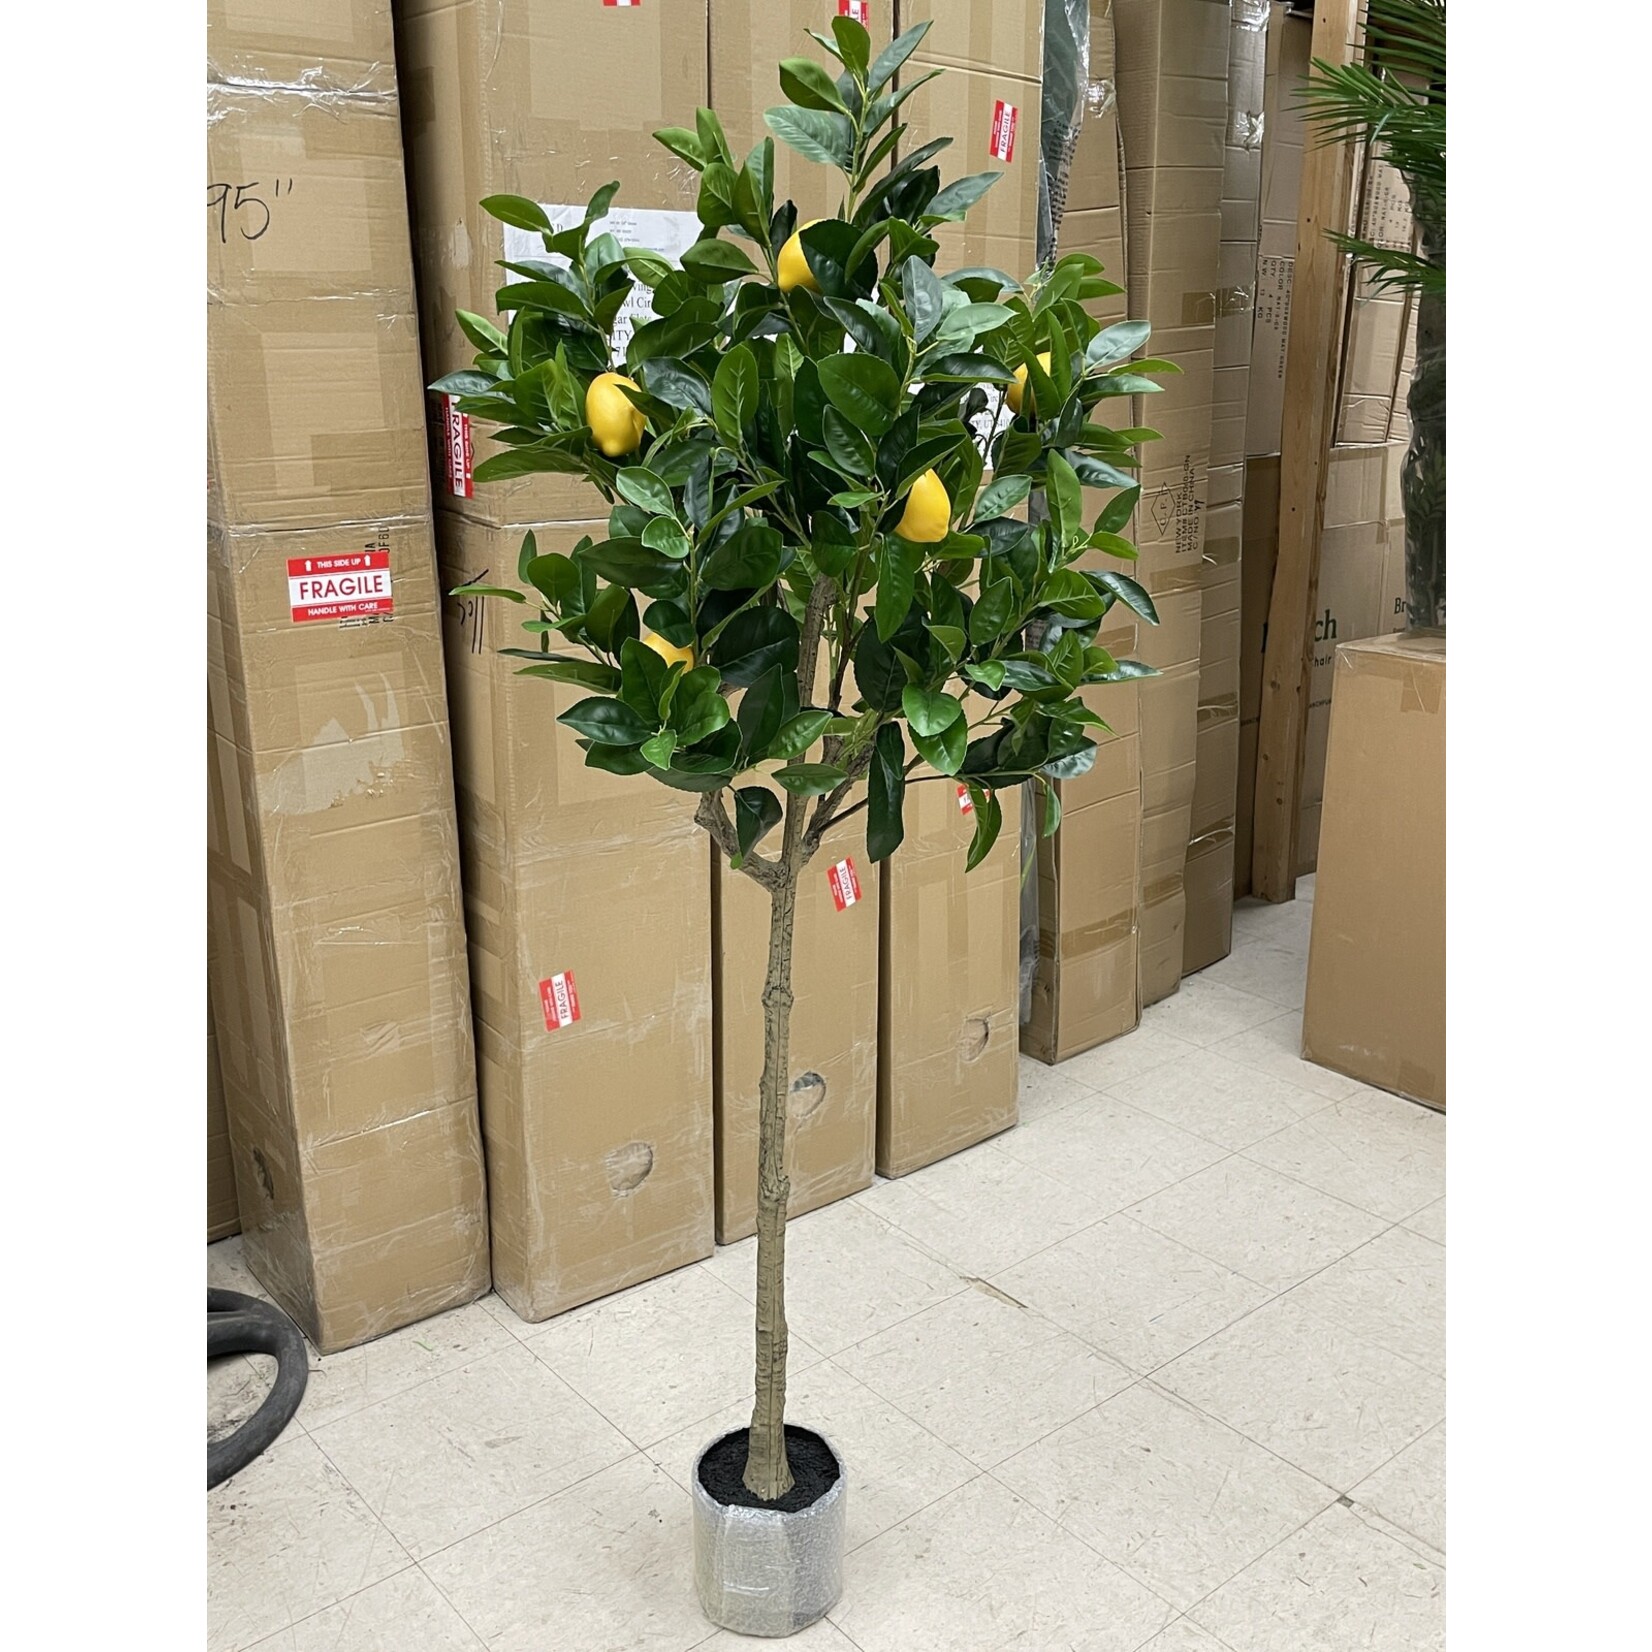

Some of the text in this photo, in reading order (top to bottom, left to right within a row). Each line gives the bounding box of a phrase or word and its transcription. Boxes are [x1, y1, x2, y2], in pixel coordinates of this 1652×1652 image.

[317, 558, 362, 569] THIS SIDE UP
[299, 575, 384, 601] FRAGILE
[307, 602, 379, 616] HANDLE WITH CARE
[555, 979, 570, 1020] FRAGILE
